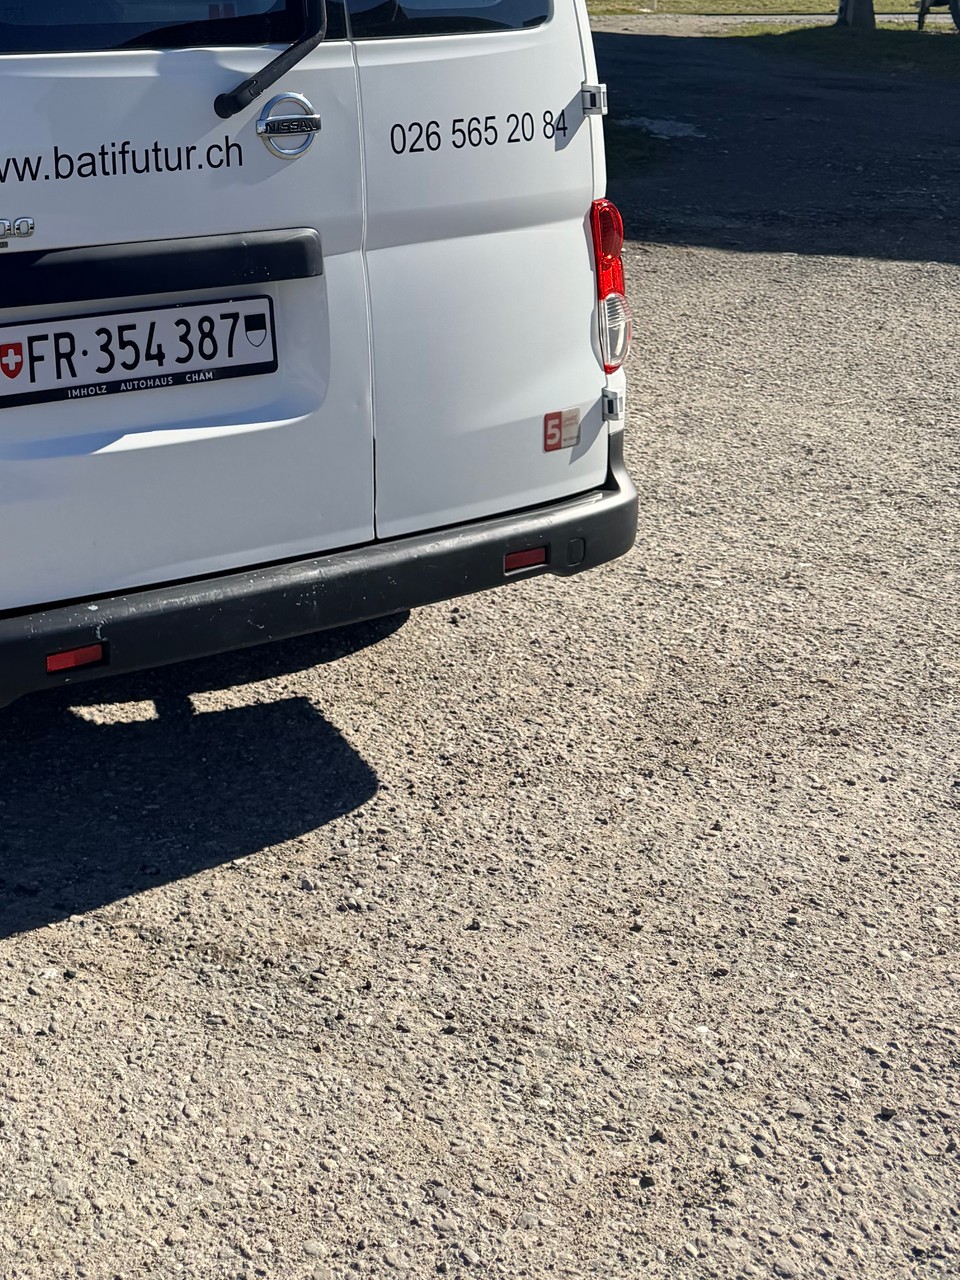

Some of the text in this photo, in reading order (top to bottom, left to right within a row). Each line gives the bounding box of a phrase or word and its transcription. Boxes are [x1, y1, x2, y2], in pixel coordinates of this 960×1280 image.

[265, 121, 317, 133] NISSAN
[390, 109, 568, 155] 026 565 20 84
[67, 371, 214, 398] IMHOLZ AUTOHAUS CHAM
[547, 419, 560, 445] 5
